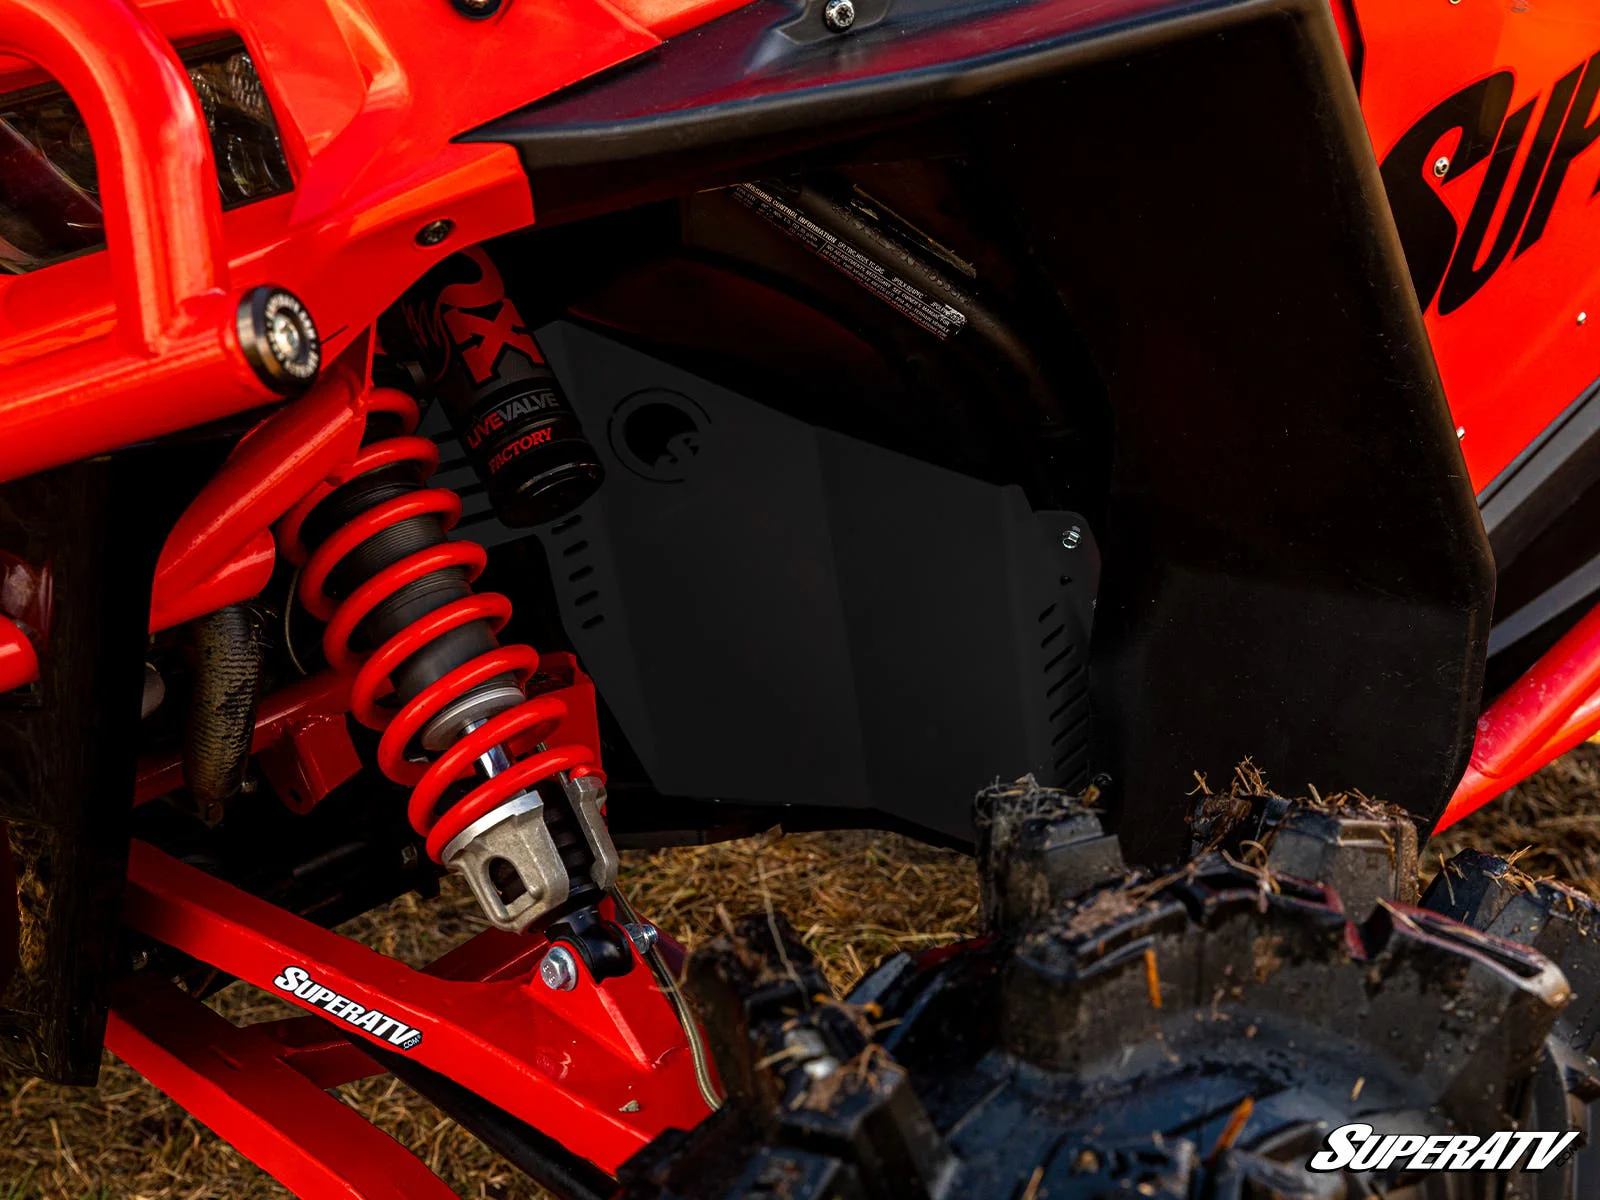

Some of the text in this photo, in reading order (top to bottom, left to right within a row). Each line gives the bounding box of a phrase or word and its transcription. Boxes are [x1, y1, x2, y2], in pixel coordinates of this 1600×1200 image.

[772, 199, 798, 219] CONTROL
[797, 216, 837, 244] INFORMATION
[487, 427, 554, 475] FACTORY
